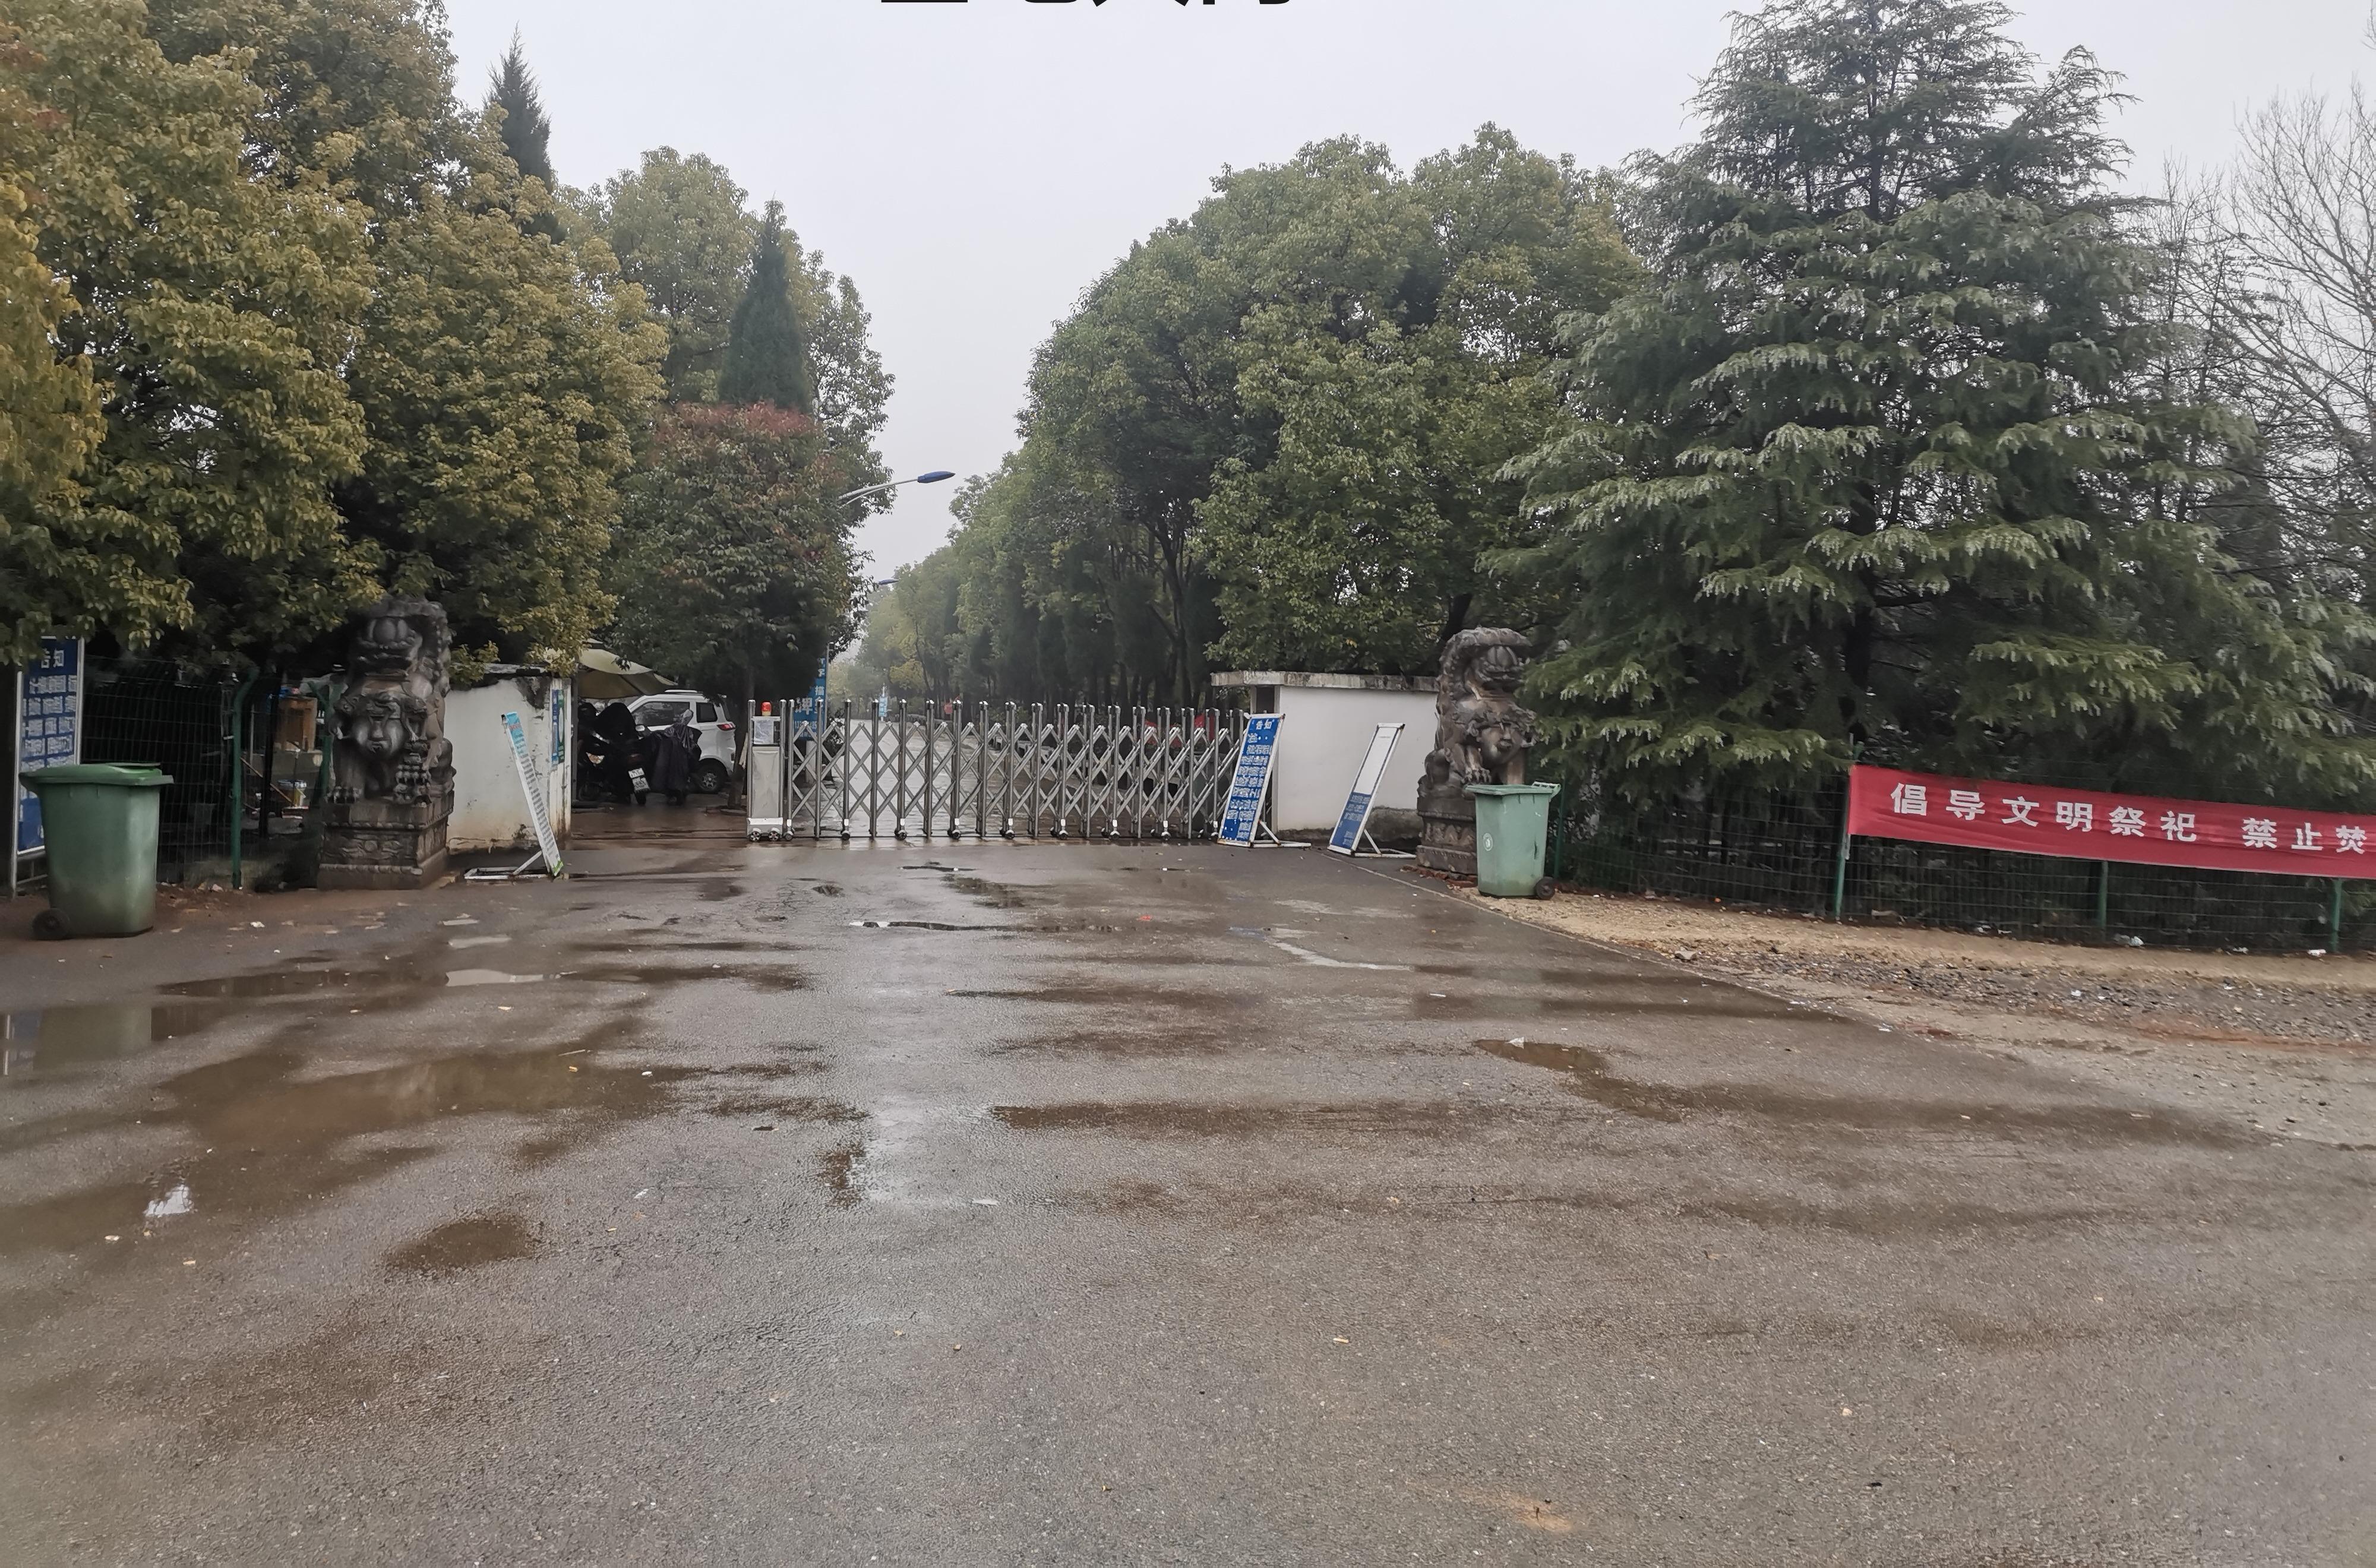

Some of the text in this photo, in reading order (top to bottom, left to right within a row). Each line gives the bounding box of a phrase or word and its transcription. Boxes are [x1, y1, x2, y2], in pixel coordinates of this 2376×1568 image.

[1890, 783, 2367, 855] 倡导文明祭祀 禁止焚
